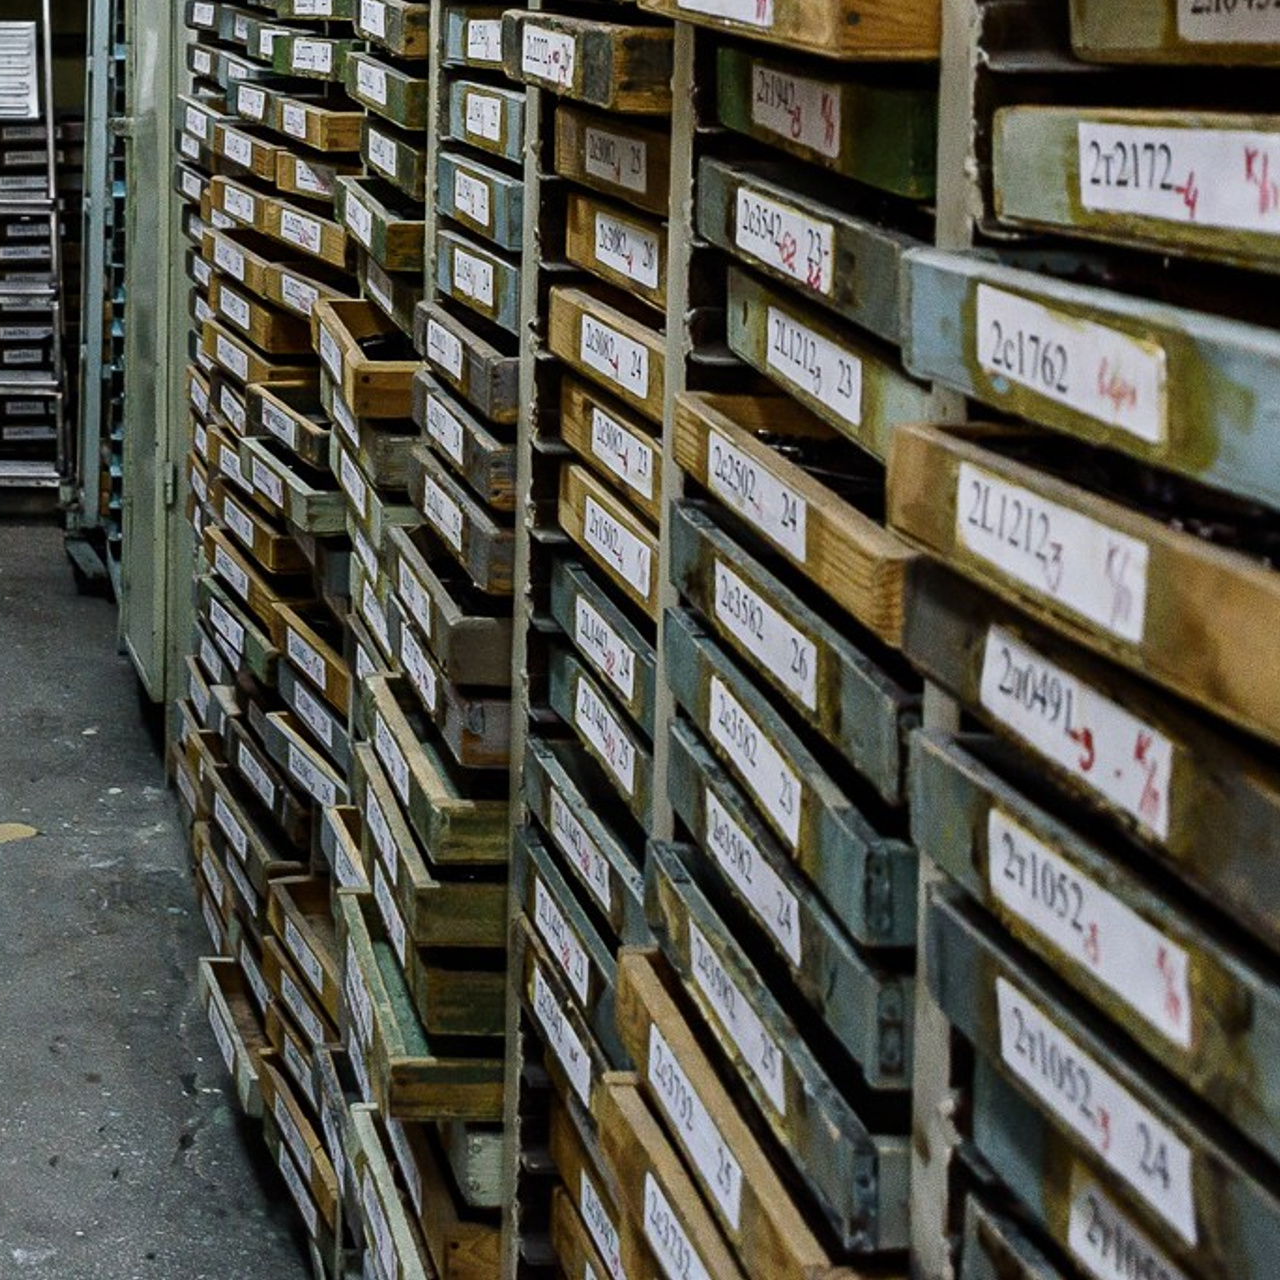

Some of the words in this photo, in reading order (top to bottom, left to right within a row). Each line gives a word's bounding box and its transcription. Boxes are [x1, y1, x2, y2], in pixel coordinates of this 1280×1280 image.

[806, 227, 823, 268] 23
[837, 358, 852, 400] 23
[991, 318, 1069, 395] 2c1762
[780, 490, 797, 535] 24
[967, 478, 1049, 563] 2L1212
[790, 635, 807, 684] 26
[1136, 1117, 1170, 1195] 24
